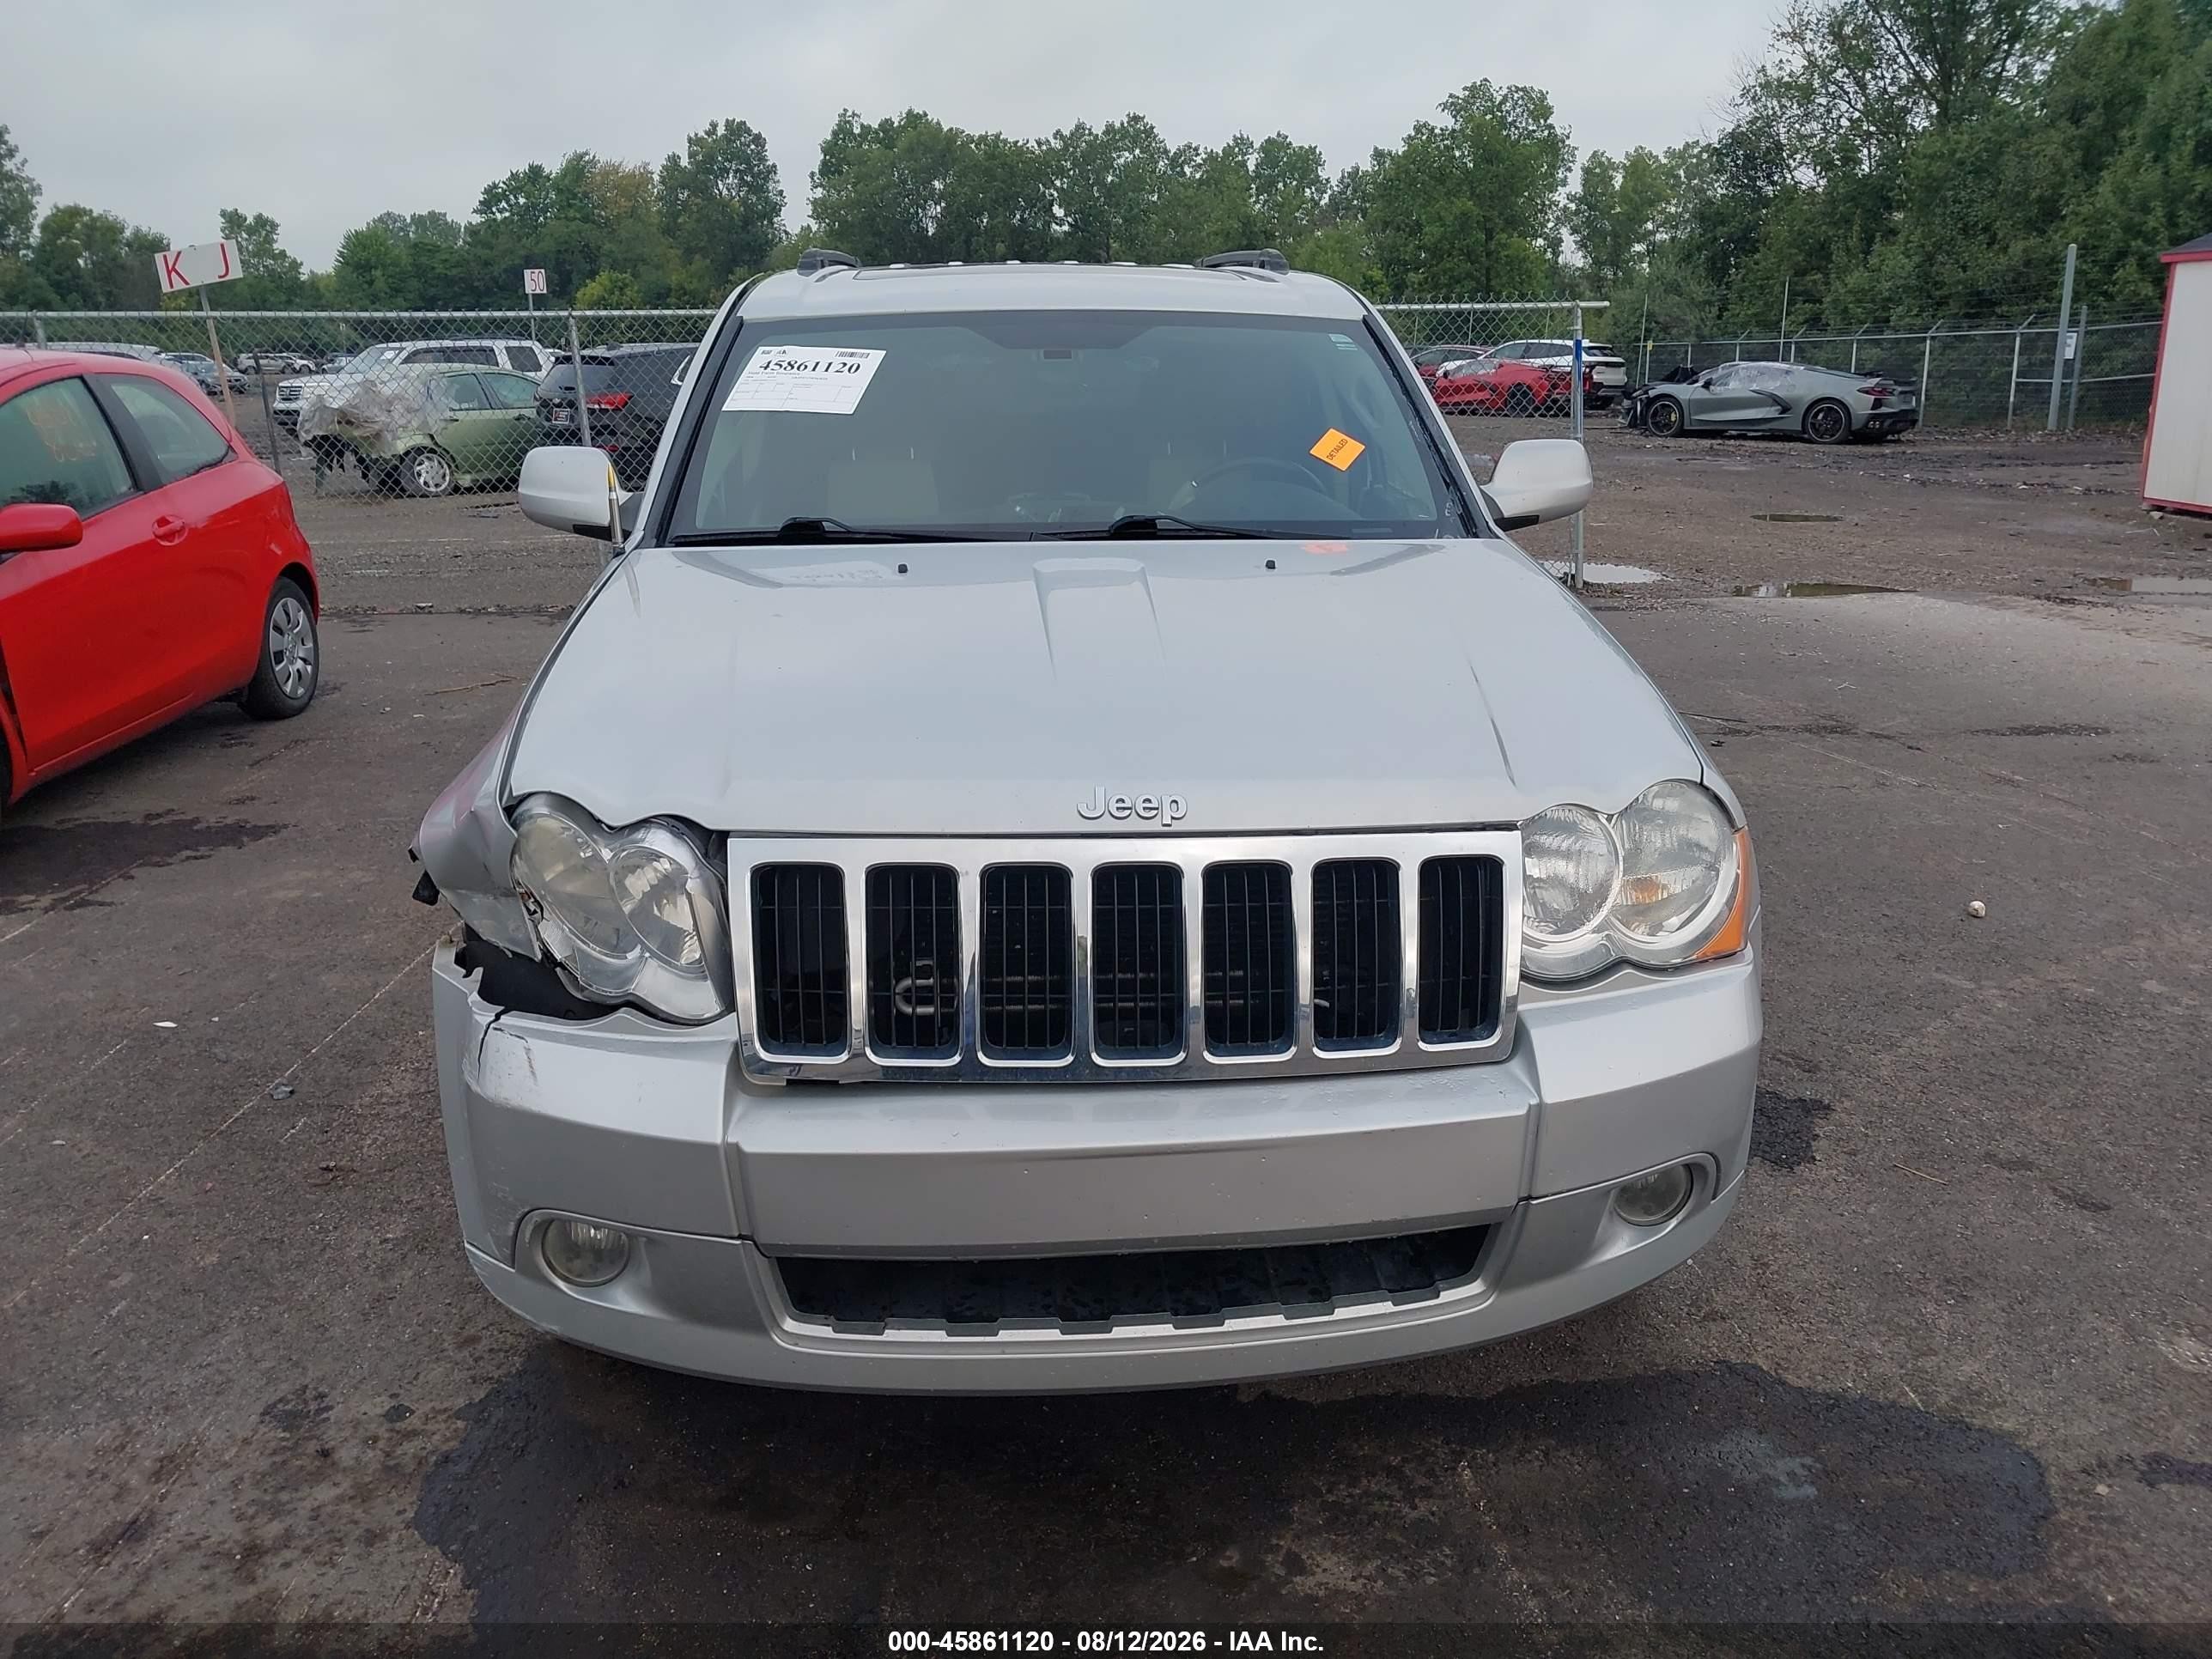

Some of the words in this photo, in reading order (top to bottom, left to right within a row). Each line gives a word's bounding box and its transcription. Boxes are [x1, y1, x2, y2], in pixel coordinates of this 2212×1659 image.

[162, 251, 190, 289] K
[218, 243, 230, 278] J
[530, 270, 544, 291] 50
[759, 359, 861, 374] 45861120
[1326, 438, 1348, 460] DETAILED
[1077, 785, 1188, 827] Jeep
